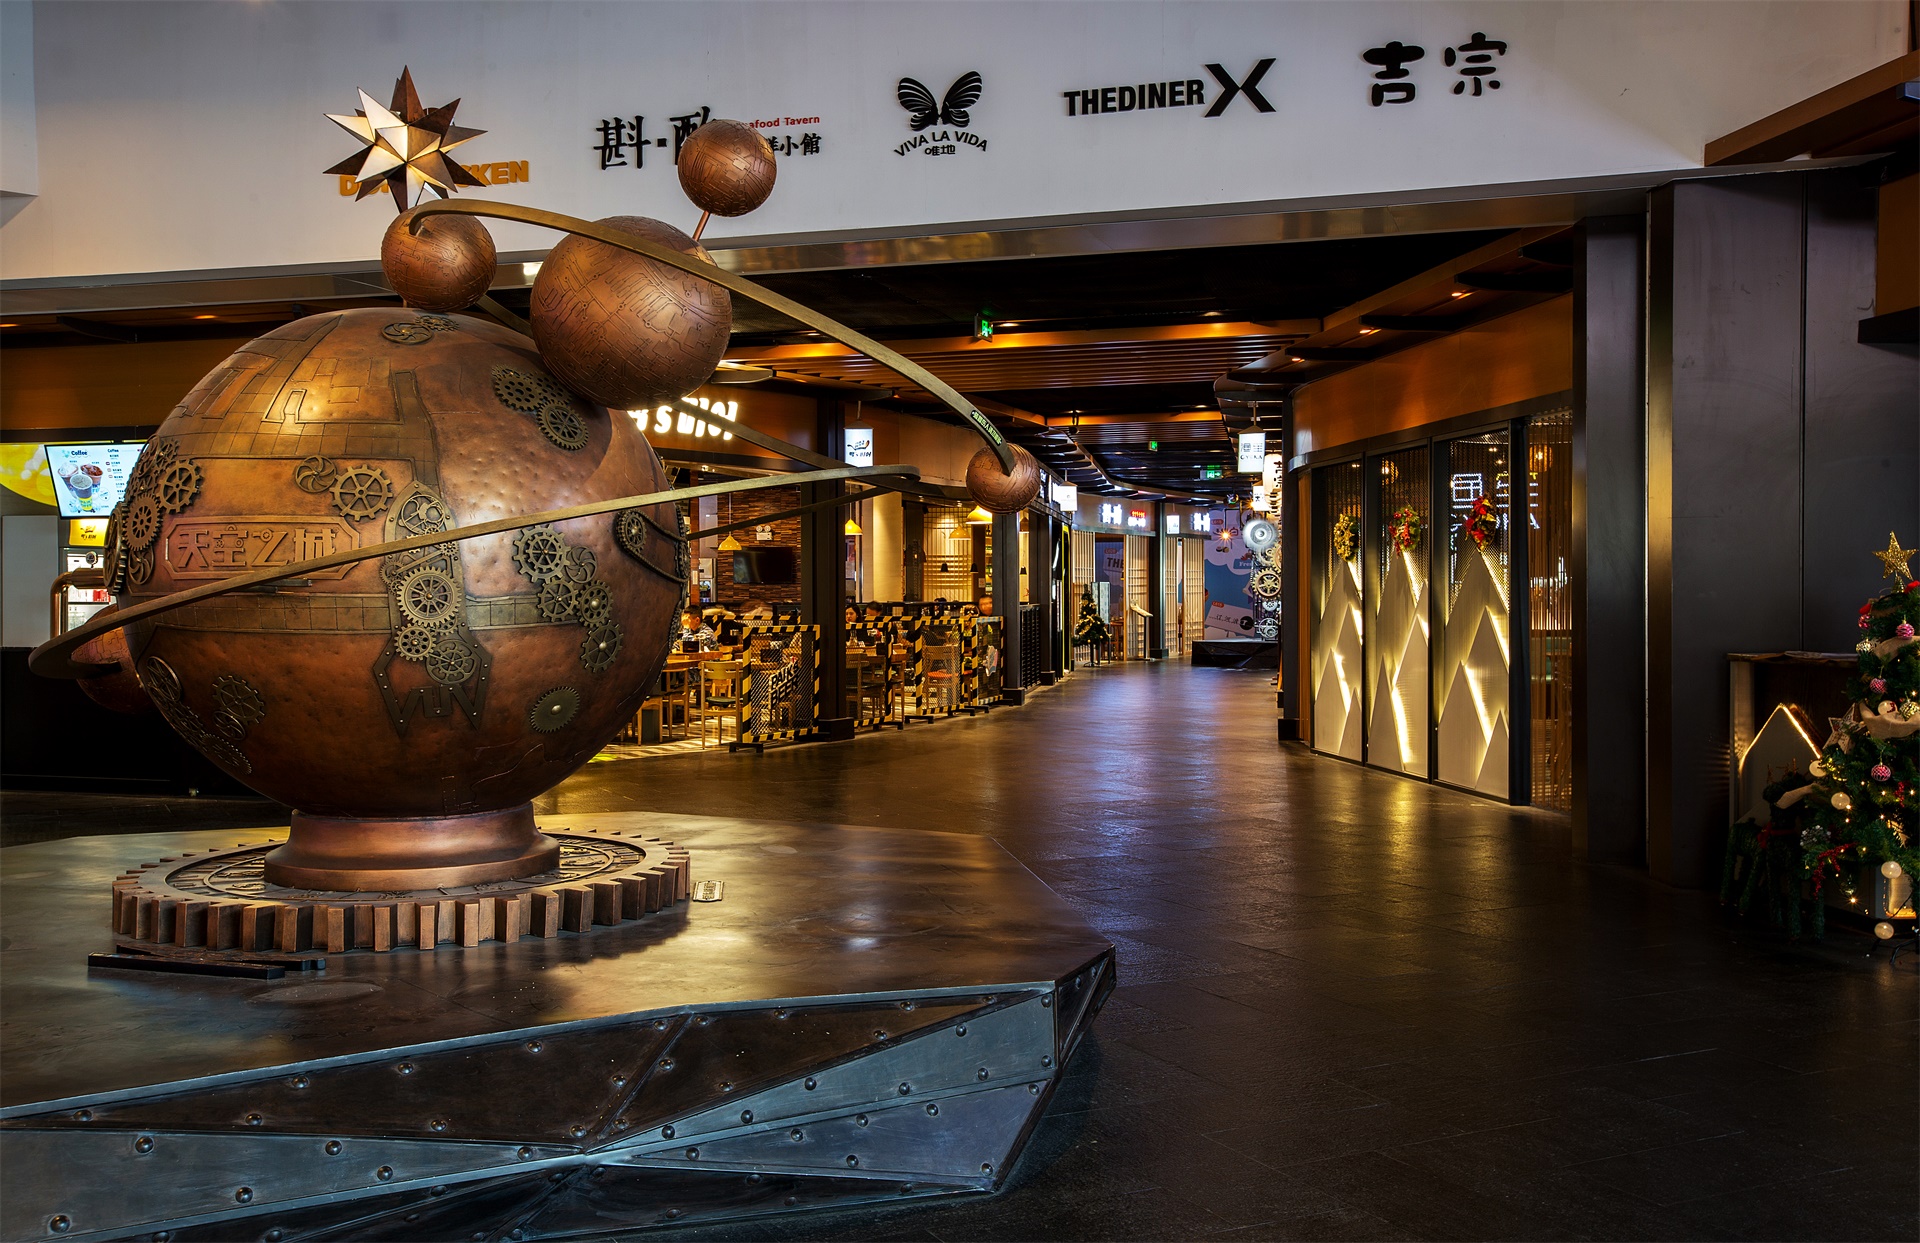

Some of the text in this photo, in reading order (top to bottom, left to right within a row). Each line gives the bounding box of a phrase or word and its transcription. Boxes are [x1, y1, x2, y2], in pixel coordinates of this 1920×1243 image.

[749, 116, 820, 129] afood Tavern
[894, 130, 988, 157] VIVA LA VIDA
[176, 524, 337, 568] 天空之城
